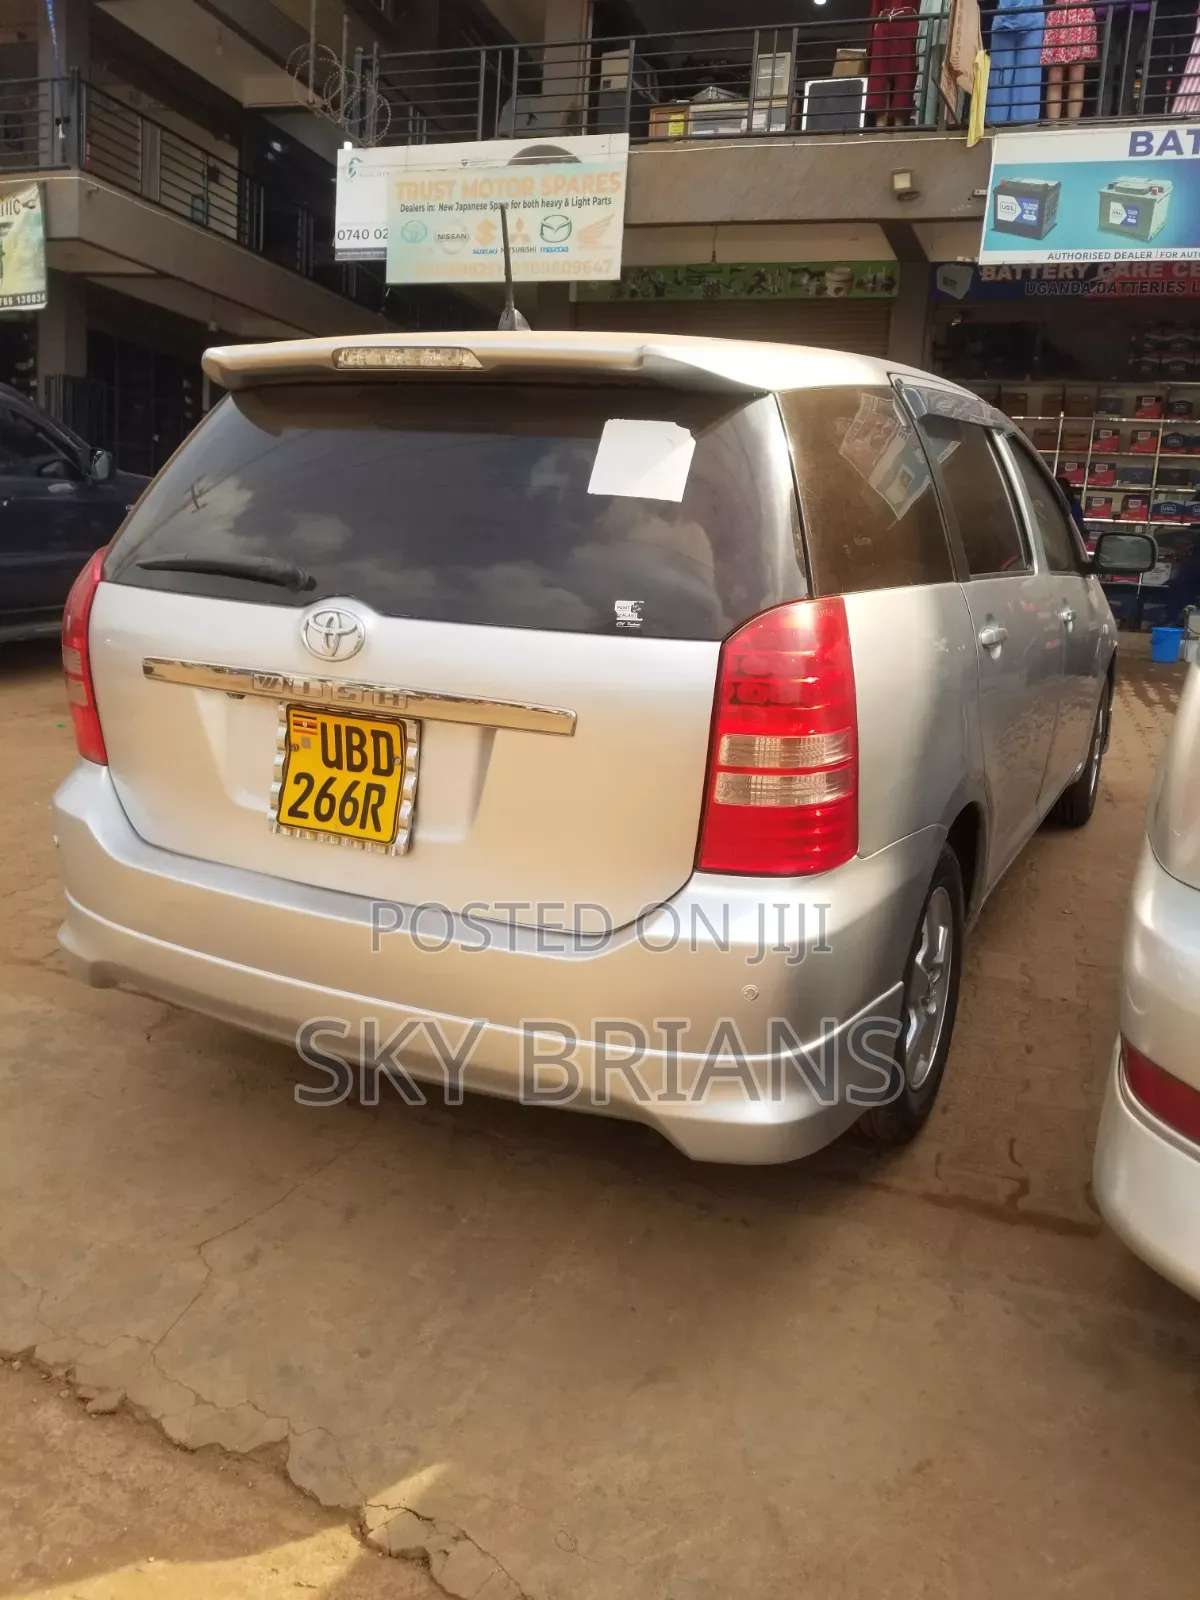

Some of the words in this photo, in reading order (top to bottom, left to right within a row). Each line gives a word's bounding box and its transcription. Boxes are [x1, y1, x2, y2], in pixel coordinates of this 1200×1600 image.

[1128, 129, 1200, 157] BAT
[395, 179, 457, 201] TRUST
[461, 176, 536, 200] MOTOR
[541, 171, 622, 197] SPARES
[400, 203, 426, 213] Dealers
[438, 202, 454, 212] New
[455, 201, 487, 214] Japanese
[511, 200, 521, 210] for
[522, 198, 540, 209] both
[541, 197, 563, 210] heavy
[564, 197, 570, 207] &
[571, 196, 591, 209] Light
[592, 196, 612, 206] Parts
[337, 229, 370, 241] 0740
[472, 247, 498, 255] SUZUKI
[1047, 251, 1111, 260] AUTHORISED
[1113, 251, 1153, 260] DEALER
[1159, 251, 1178, 259] FOR
[981, 262, 1092, 281] BATTERY
[1097, 261, 1164, 278] CARE
[1024, 280, 1091, 296] UGANDA
[1095, 280, 1187, 295] BATTERIES
[320, 721, 395, 777] UBD
[287, 771, 387, 833] 266R
